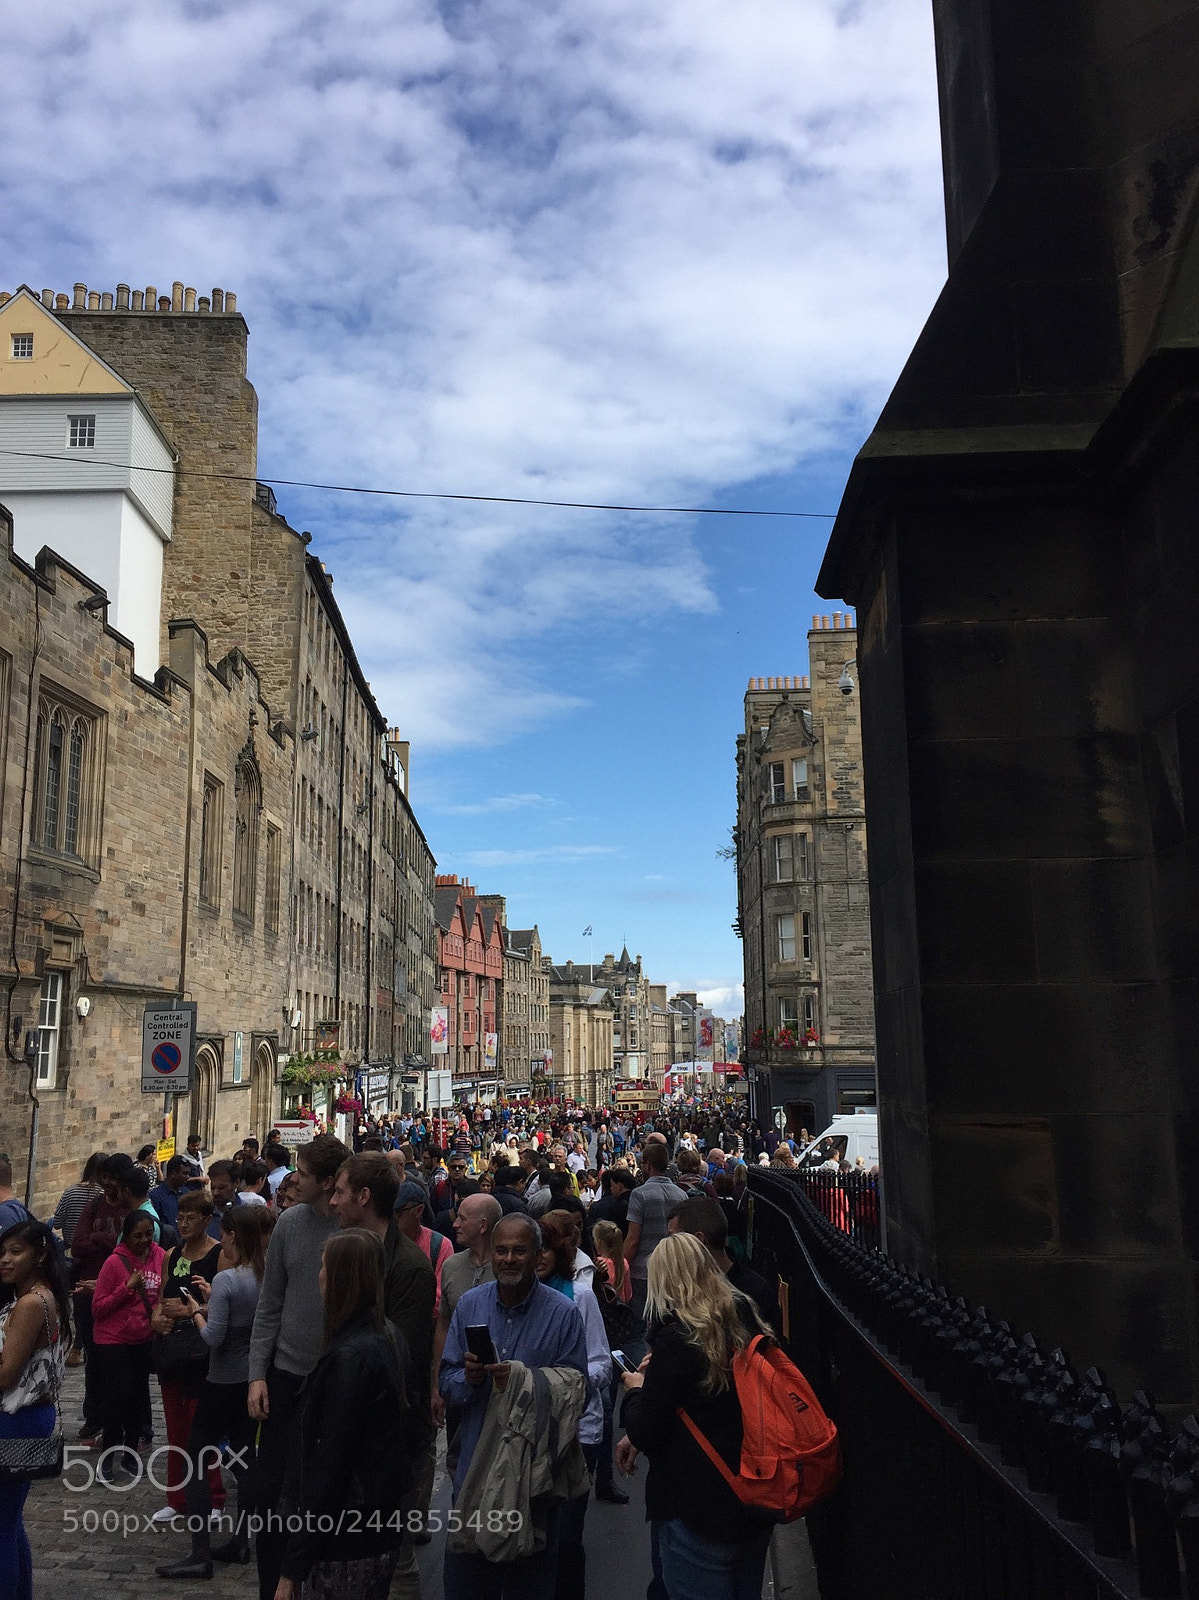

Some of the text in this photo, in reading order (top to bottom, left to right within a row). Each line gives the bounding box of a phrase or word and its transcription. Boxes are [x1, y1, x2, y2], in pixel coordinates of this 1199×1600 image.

[153, 1013, 183, 1021] Central
[147, 1021, 189, 1030] Controlled
[152, 1031, 182, 1040] ZONE
